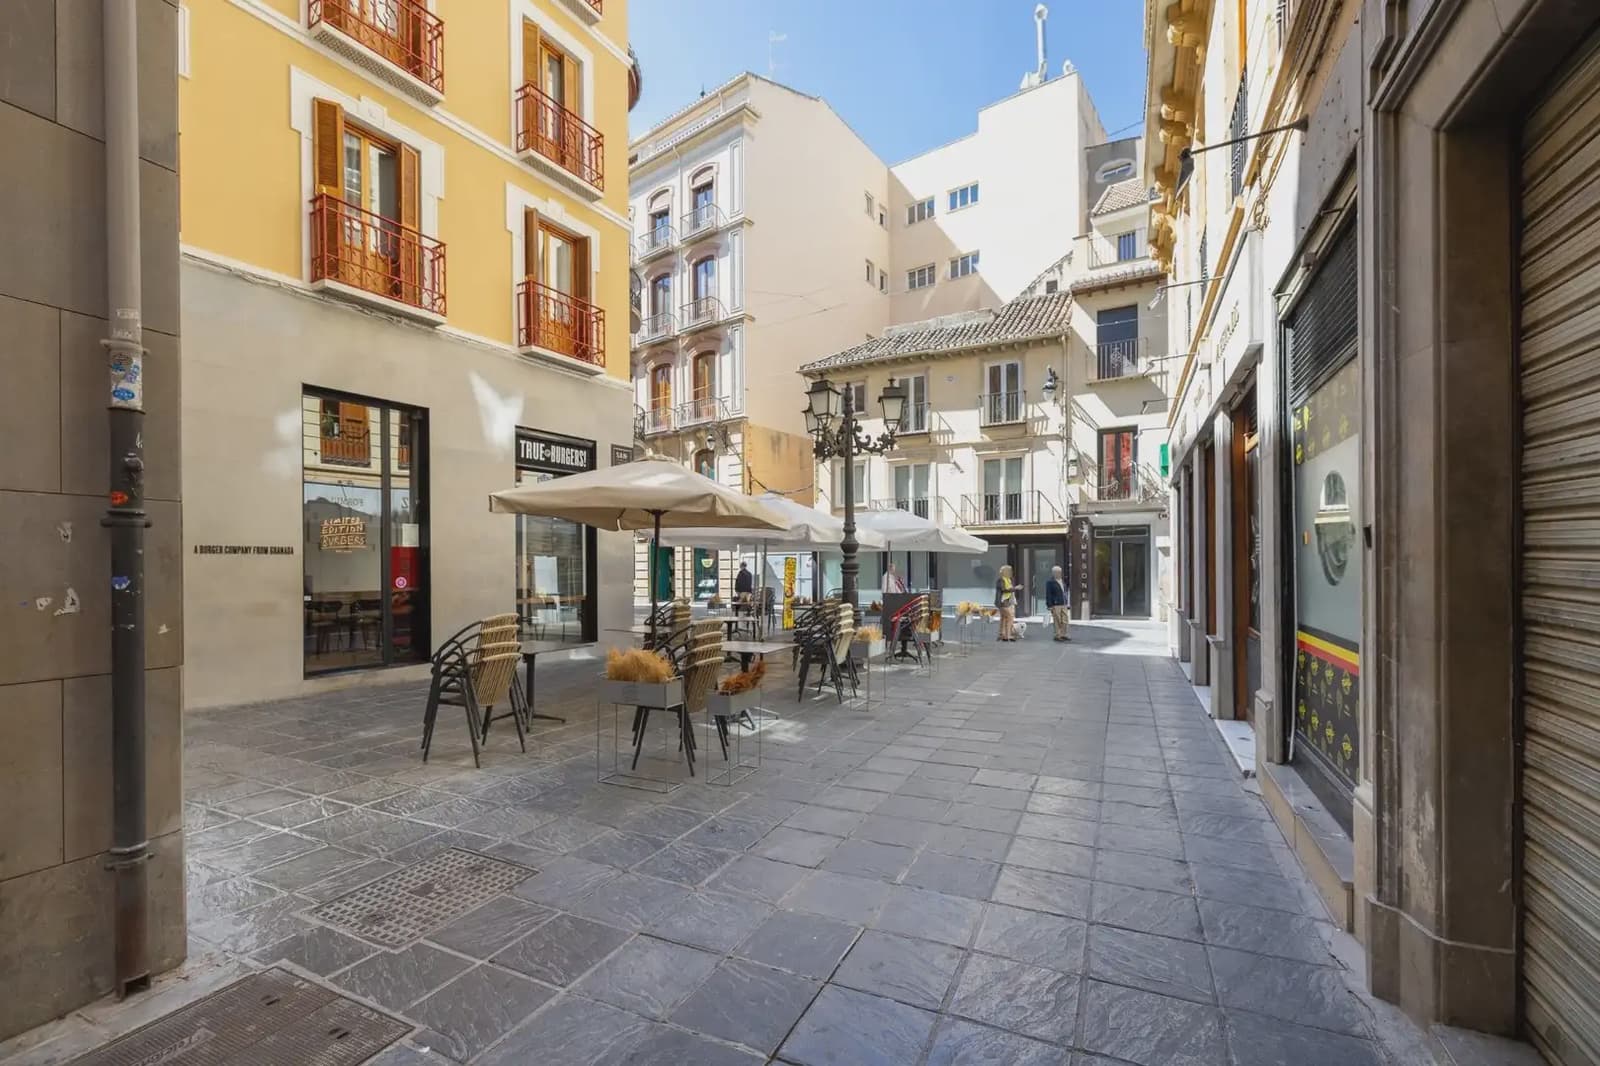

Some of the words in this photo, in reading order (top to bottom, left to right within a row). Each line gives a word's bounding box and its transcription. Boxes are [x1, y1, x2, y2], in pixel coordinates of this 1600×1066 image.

[520, 439, 545, 461] TRUE
[321, 523, 364, 534] EDITION
[199, 545, 223, 554] BURGER
[224, 545, 252, 555] COMPANY
[253, 546, 269, 555] FROM
[269, 546, 294, 555] GRANADA
